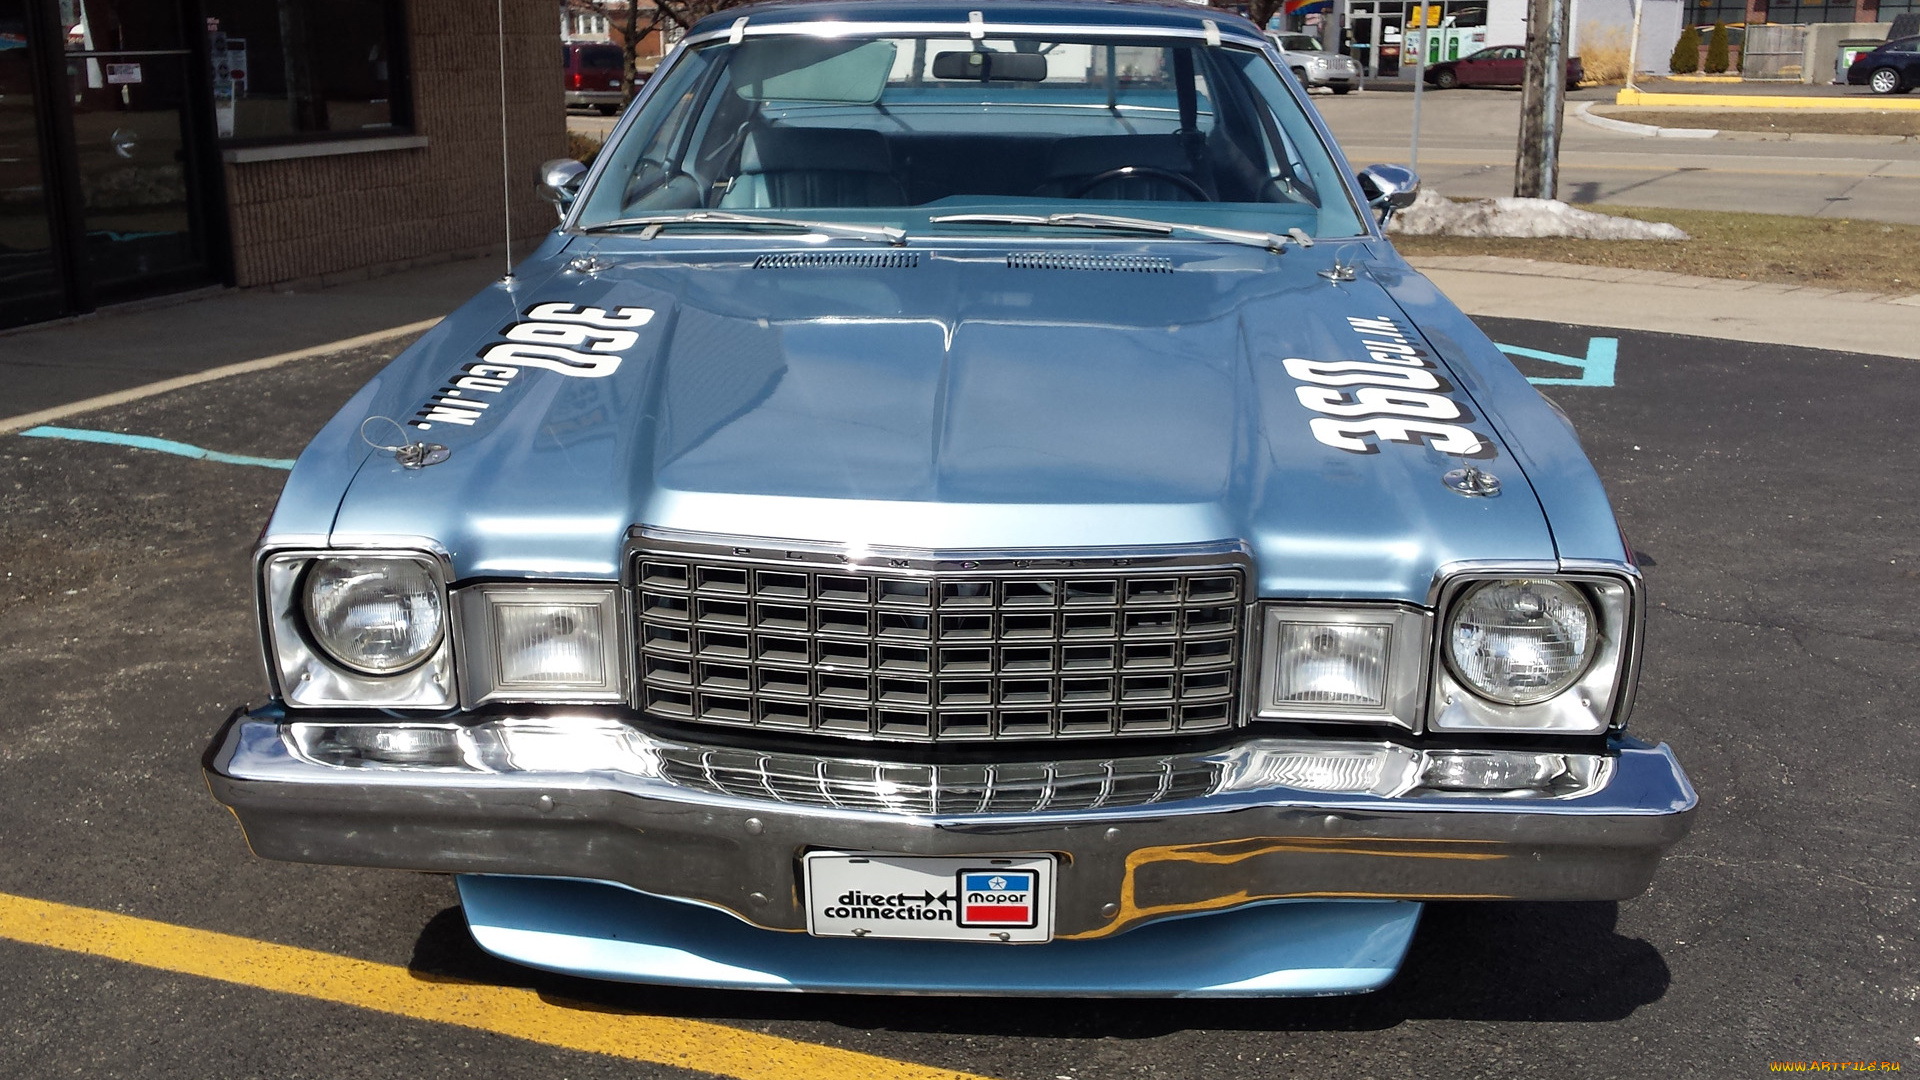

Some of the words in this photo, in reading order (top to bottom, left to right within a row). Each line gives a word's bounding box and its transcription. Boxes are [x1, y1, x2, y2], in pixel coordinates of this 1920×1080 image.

[479, 302, 655, 378] 360
[1282, 358, 1488, 456] 360
[732, 547, 1131, 570] PLYMOUTH
[838, 890, 907, 907] direct
[824, 904, 953, 921] connection
